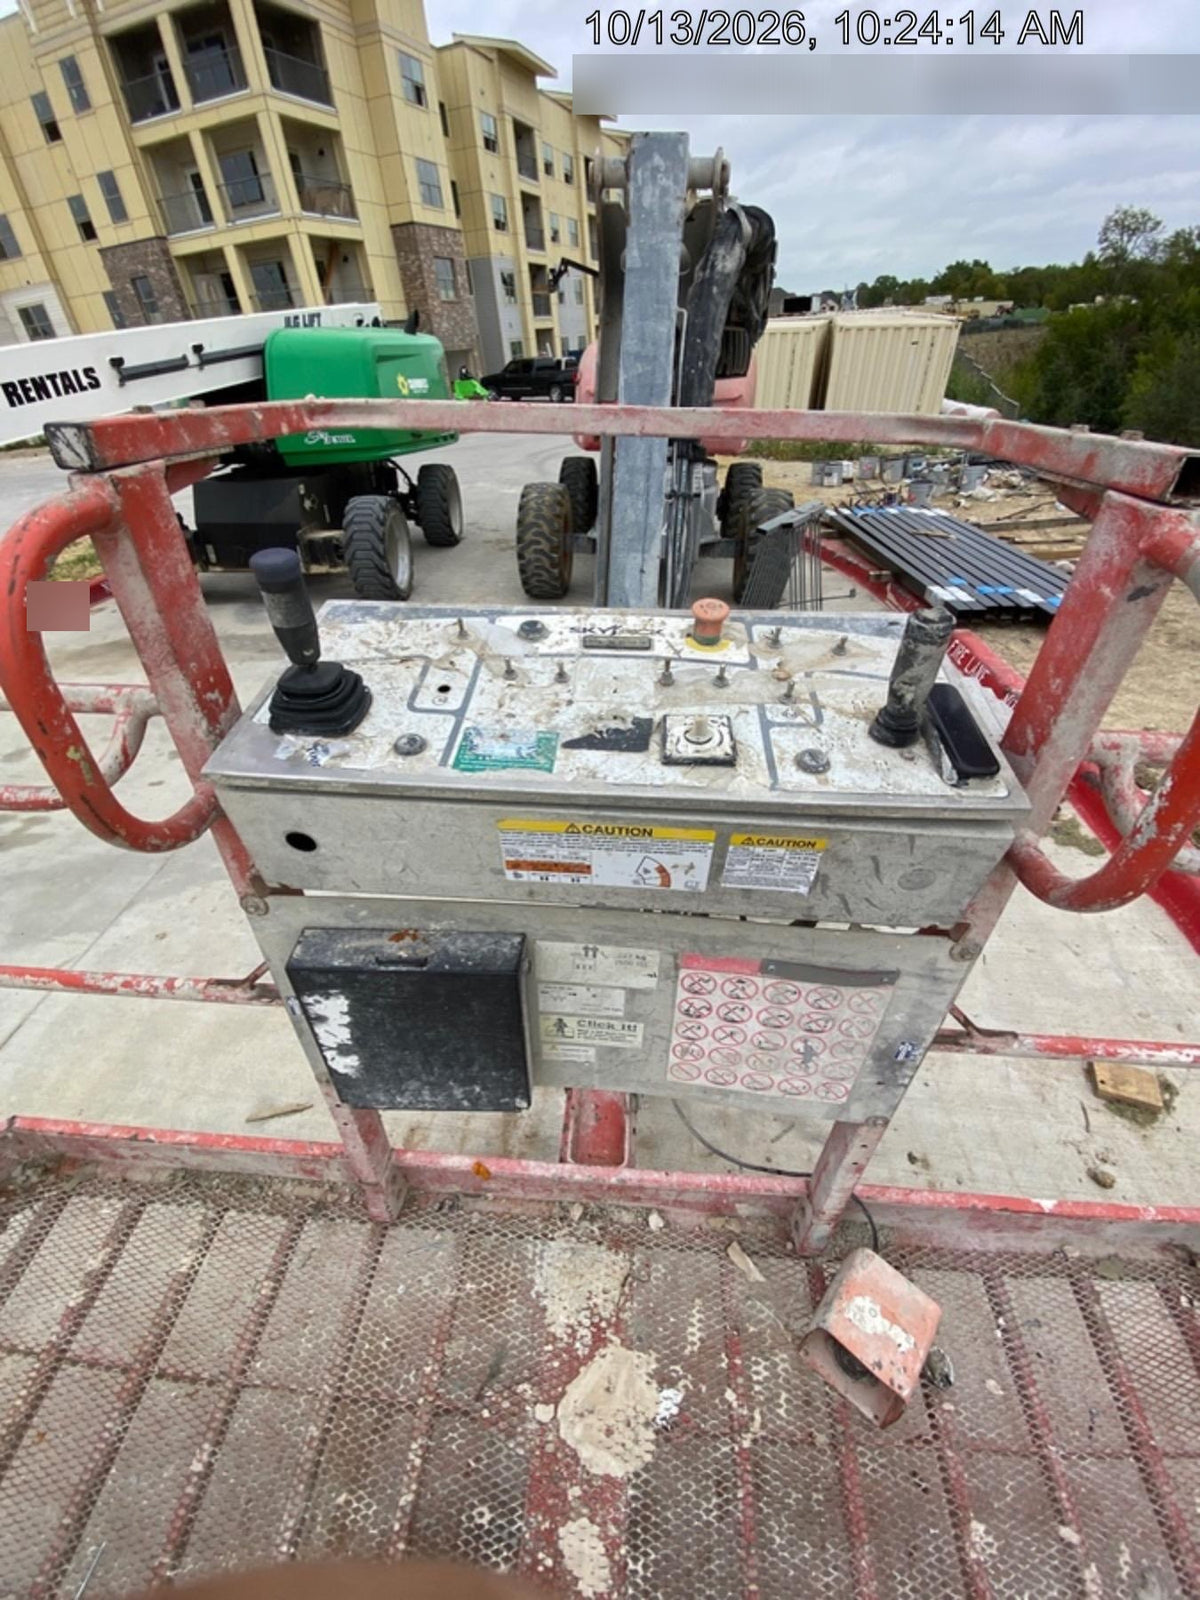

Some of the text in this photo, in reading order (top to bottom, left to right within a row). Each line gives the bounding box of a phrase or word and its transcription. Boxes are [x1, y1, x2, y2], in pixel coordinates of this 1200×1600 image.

[2, 366, 102, 408] RENTALS
[946, 639, 970, 665] FIRE
[963, 656, 991, 680] LANE
[582, 823, 654, 838] CAUTION
[756, 837, 817, 849] CAUTION
[577, 1019, 615, 1031] Click
